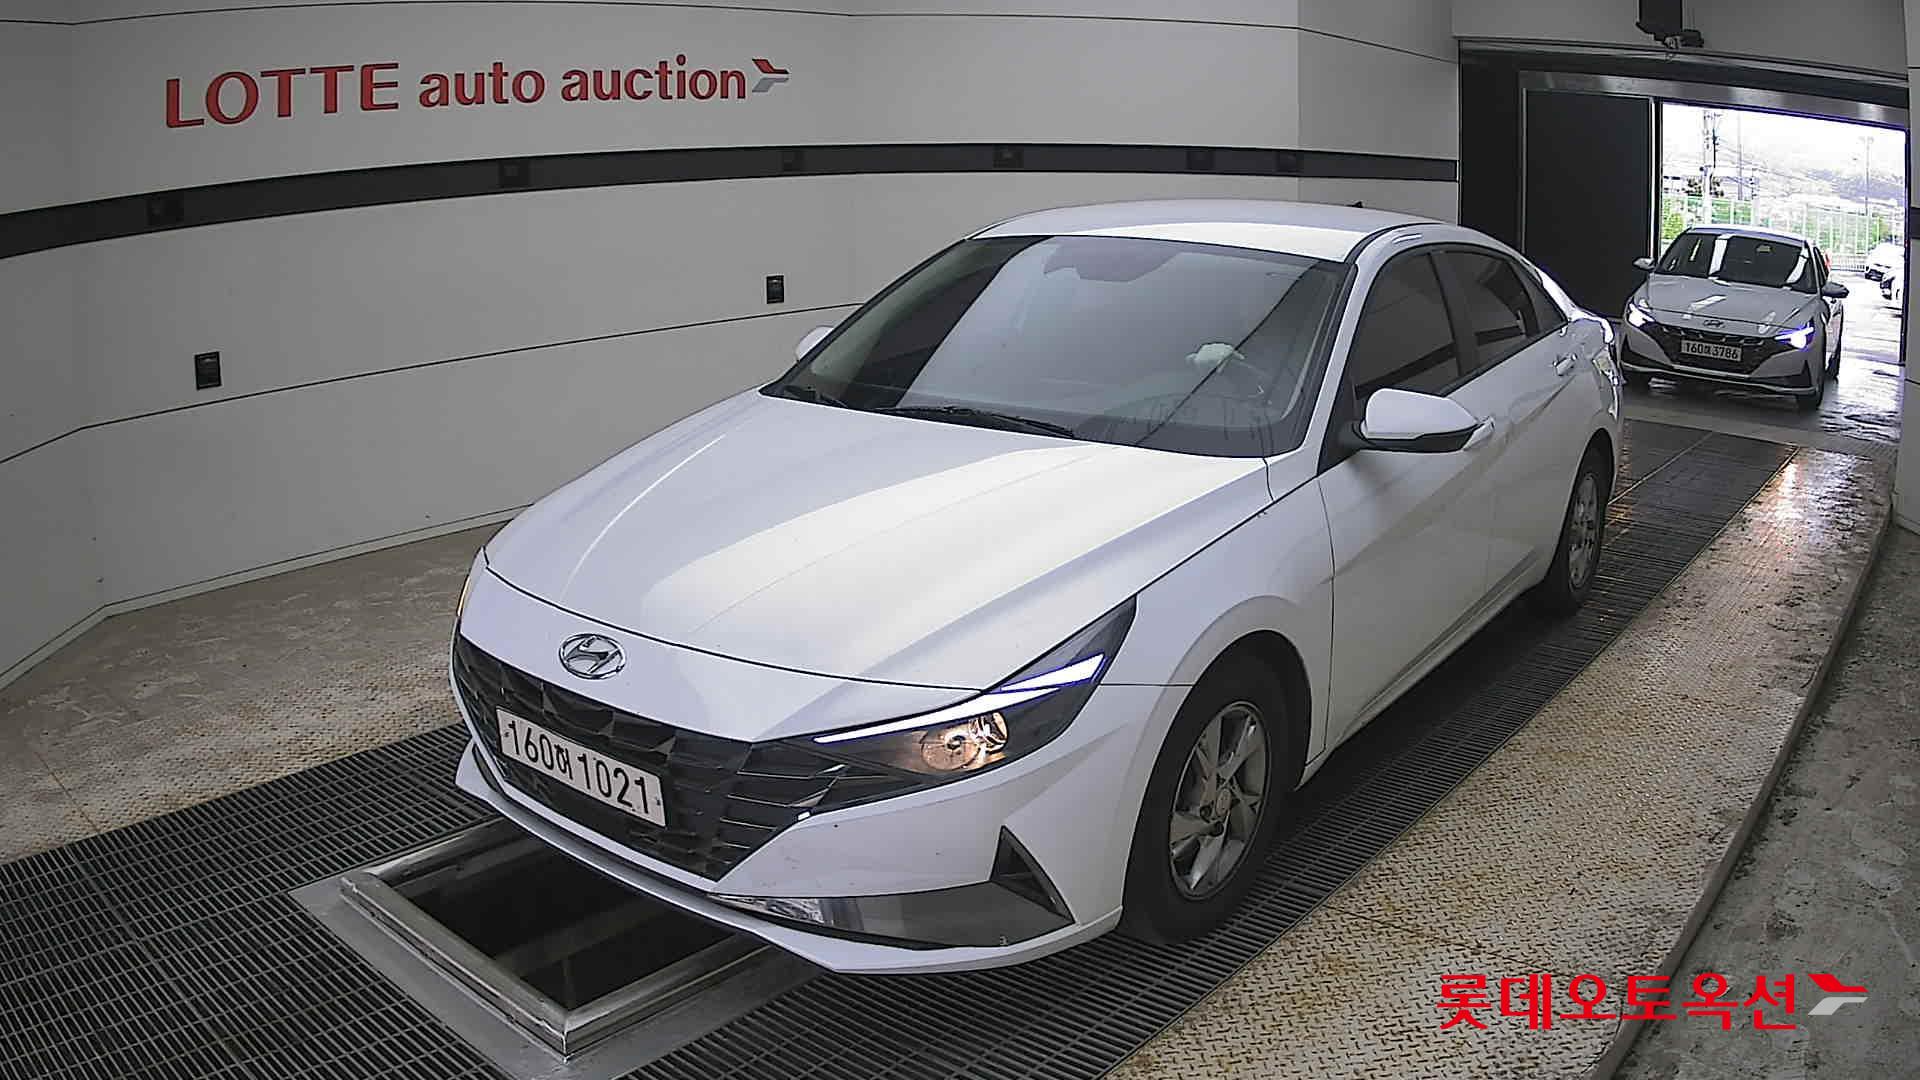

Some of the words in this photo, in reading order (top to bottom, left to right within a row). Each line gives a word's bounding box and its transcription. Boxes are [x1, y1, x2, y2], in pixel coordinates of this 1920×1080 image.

[166, 62, 400, 128] LOTTE
[418, 62, 546, 108] auto
[560, 53, 747, 101] auction
